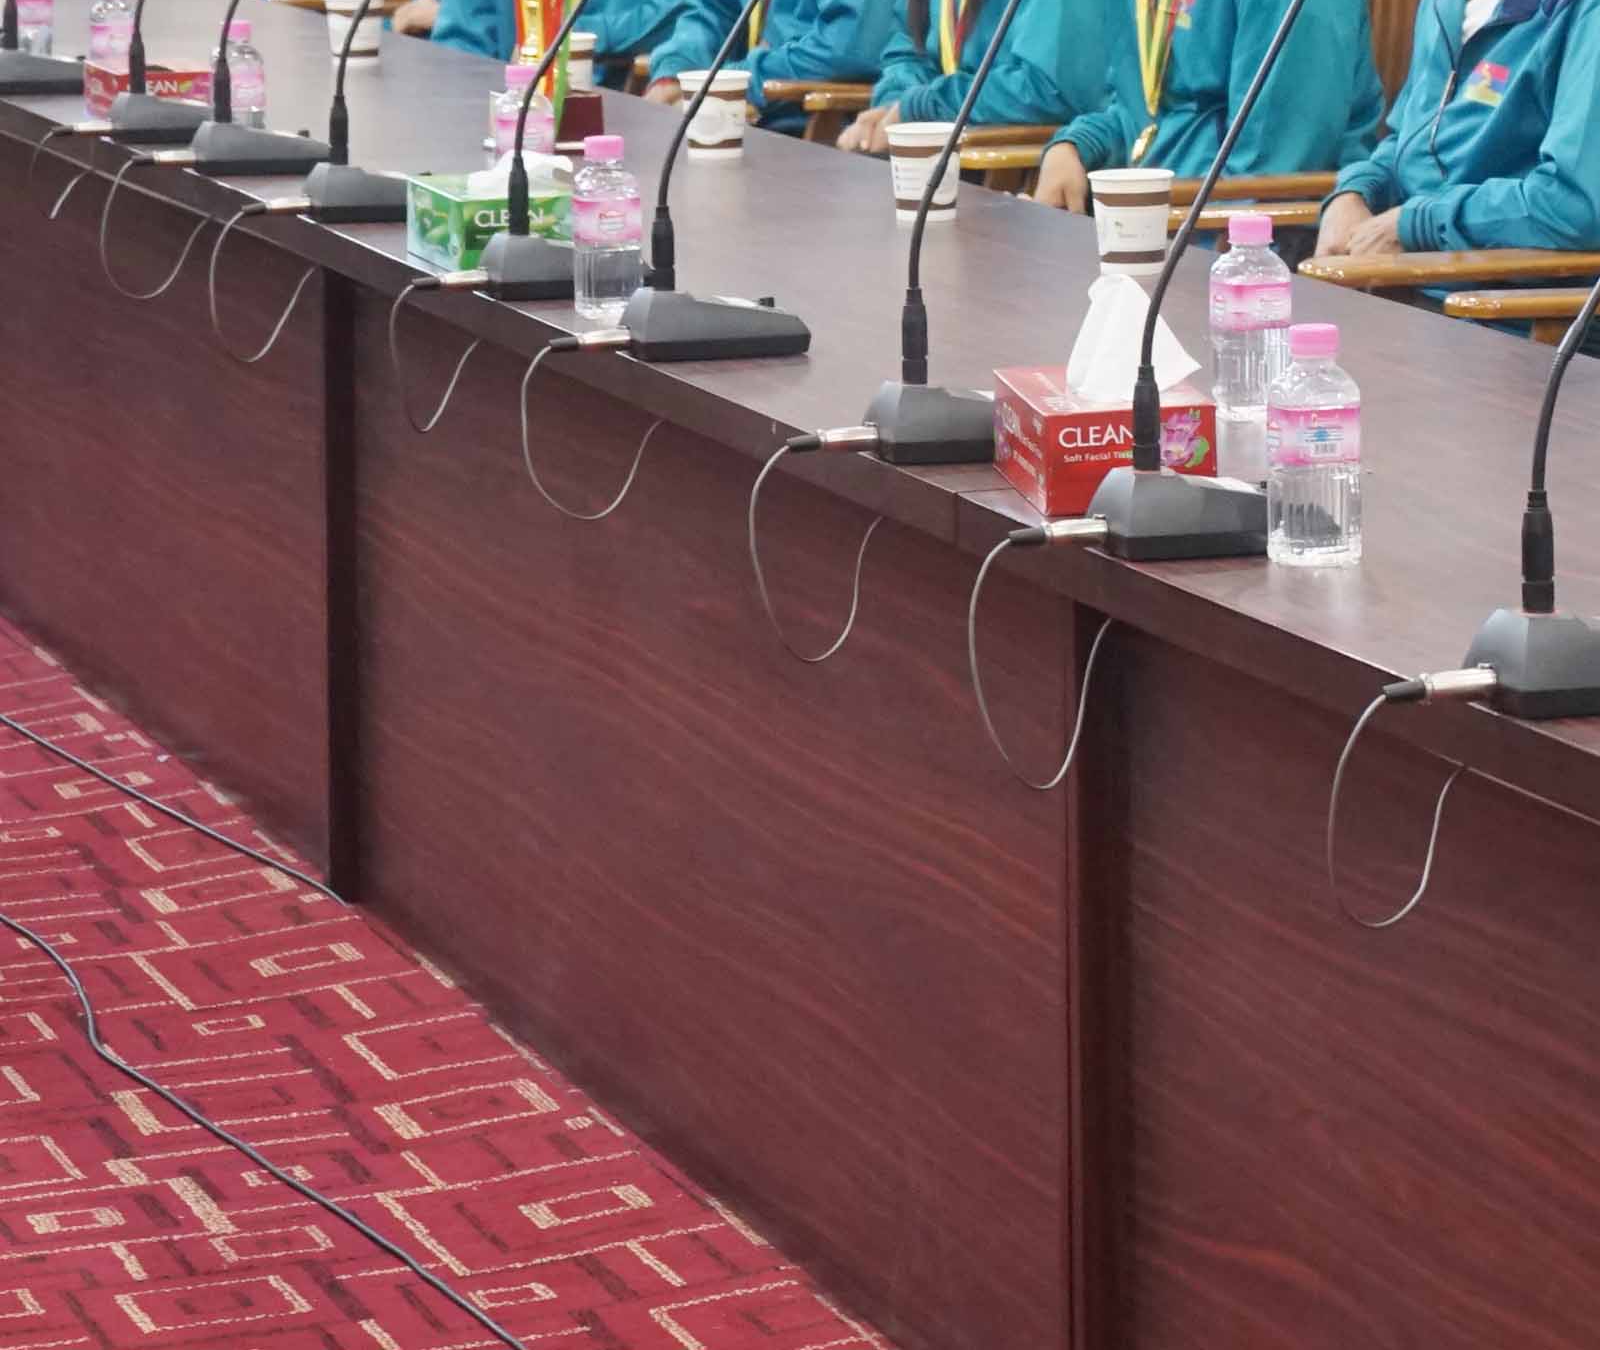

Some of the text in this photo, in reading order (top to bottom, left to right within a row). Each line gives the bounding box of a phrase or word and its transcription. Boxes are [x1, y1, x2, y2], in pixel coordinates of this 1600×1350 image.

[474, 208, 544, 228] CLEN
[1063, 454, 1083, 464] Soft
[1084, 451, 1112, 463] Facial
